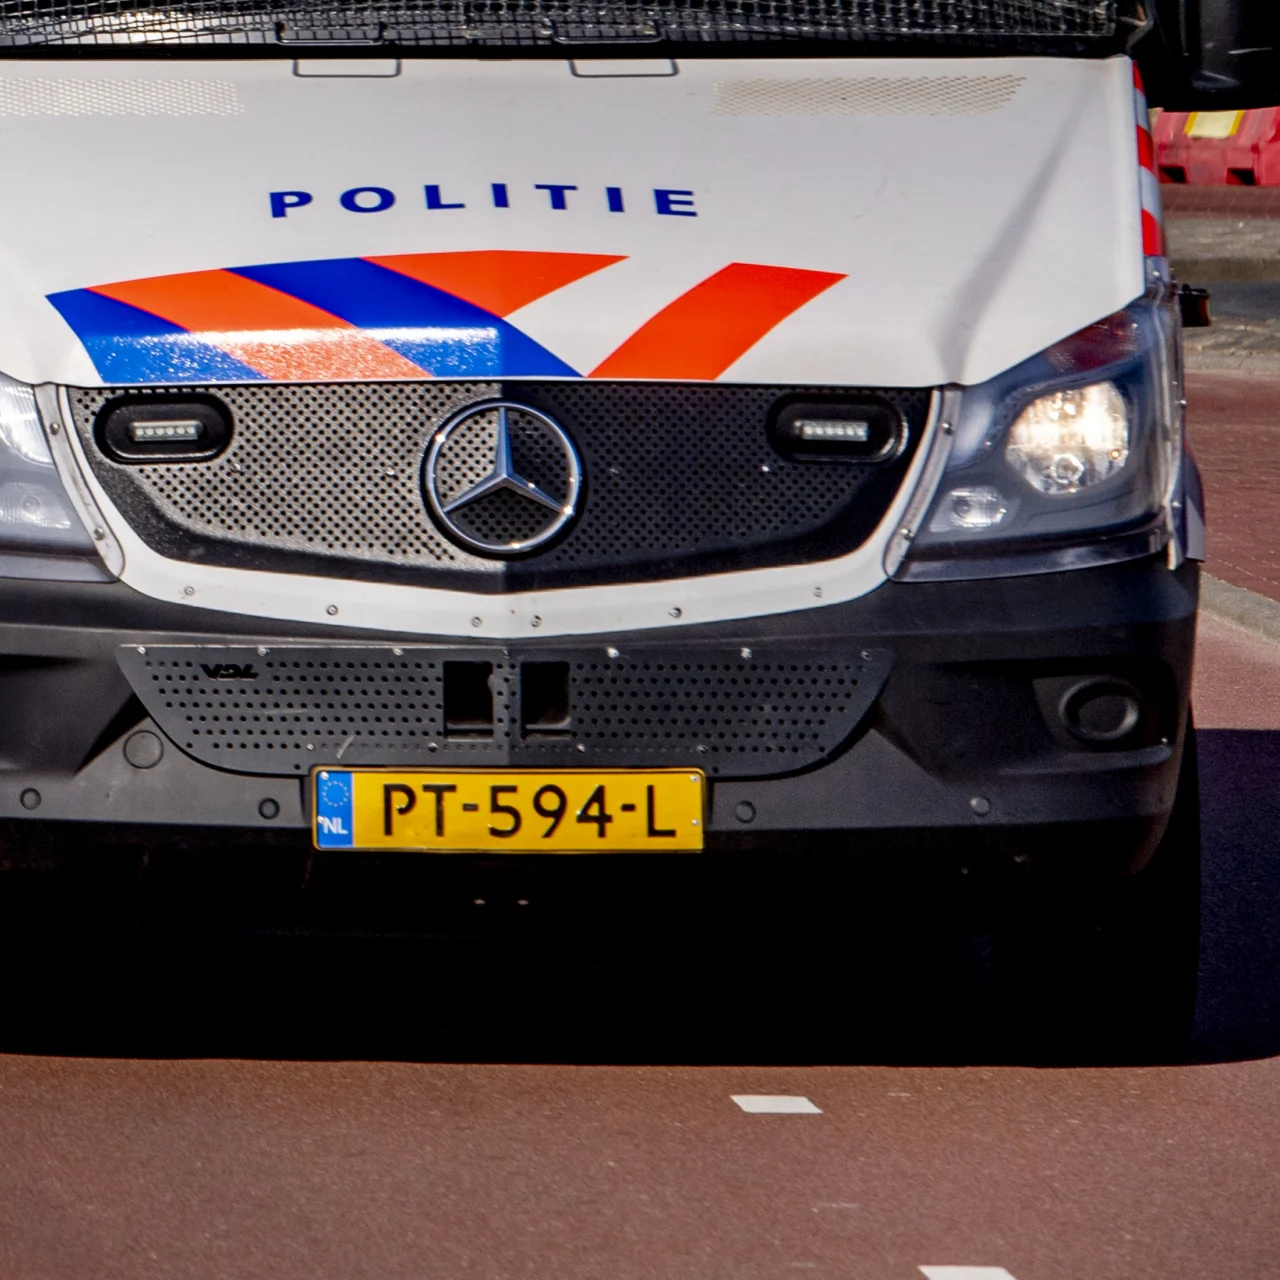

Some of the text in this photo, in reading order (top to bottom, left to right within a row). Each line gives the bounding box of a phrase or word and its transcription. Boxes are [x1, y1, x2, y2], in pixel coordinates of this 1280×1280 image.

[269, 182, 698, 218] POLITIE
[200, 664, 259, 678] VDL
[382, 783, 677, 838] PT-594-L
[321, 816, 348, 836] NL
